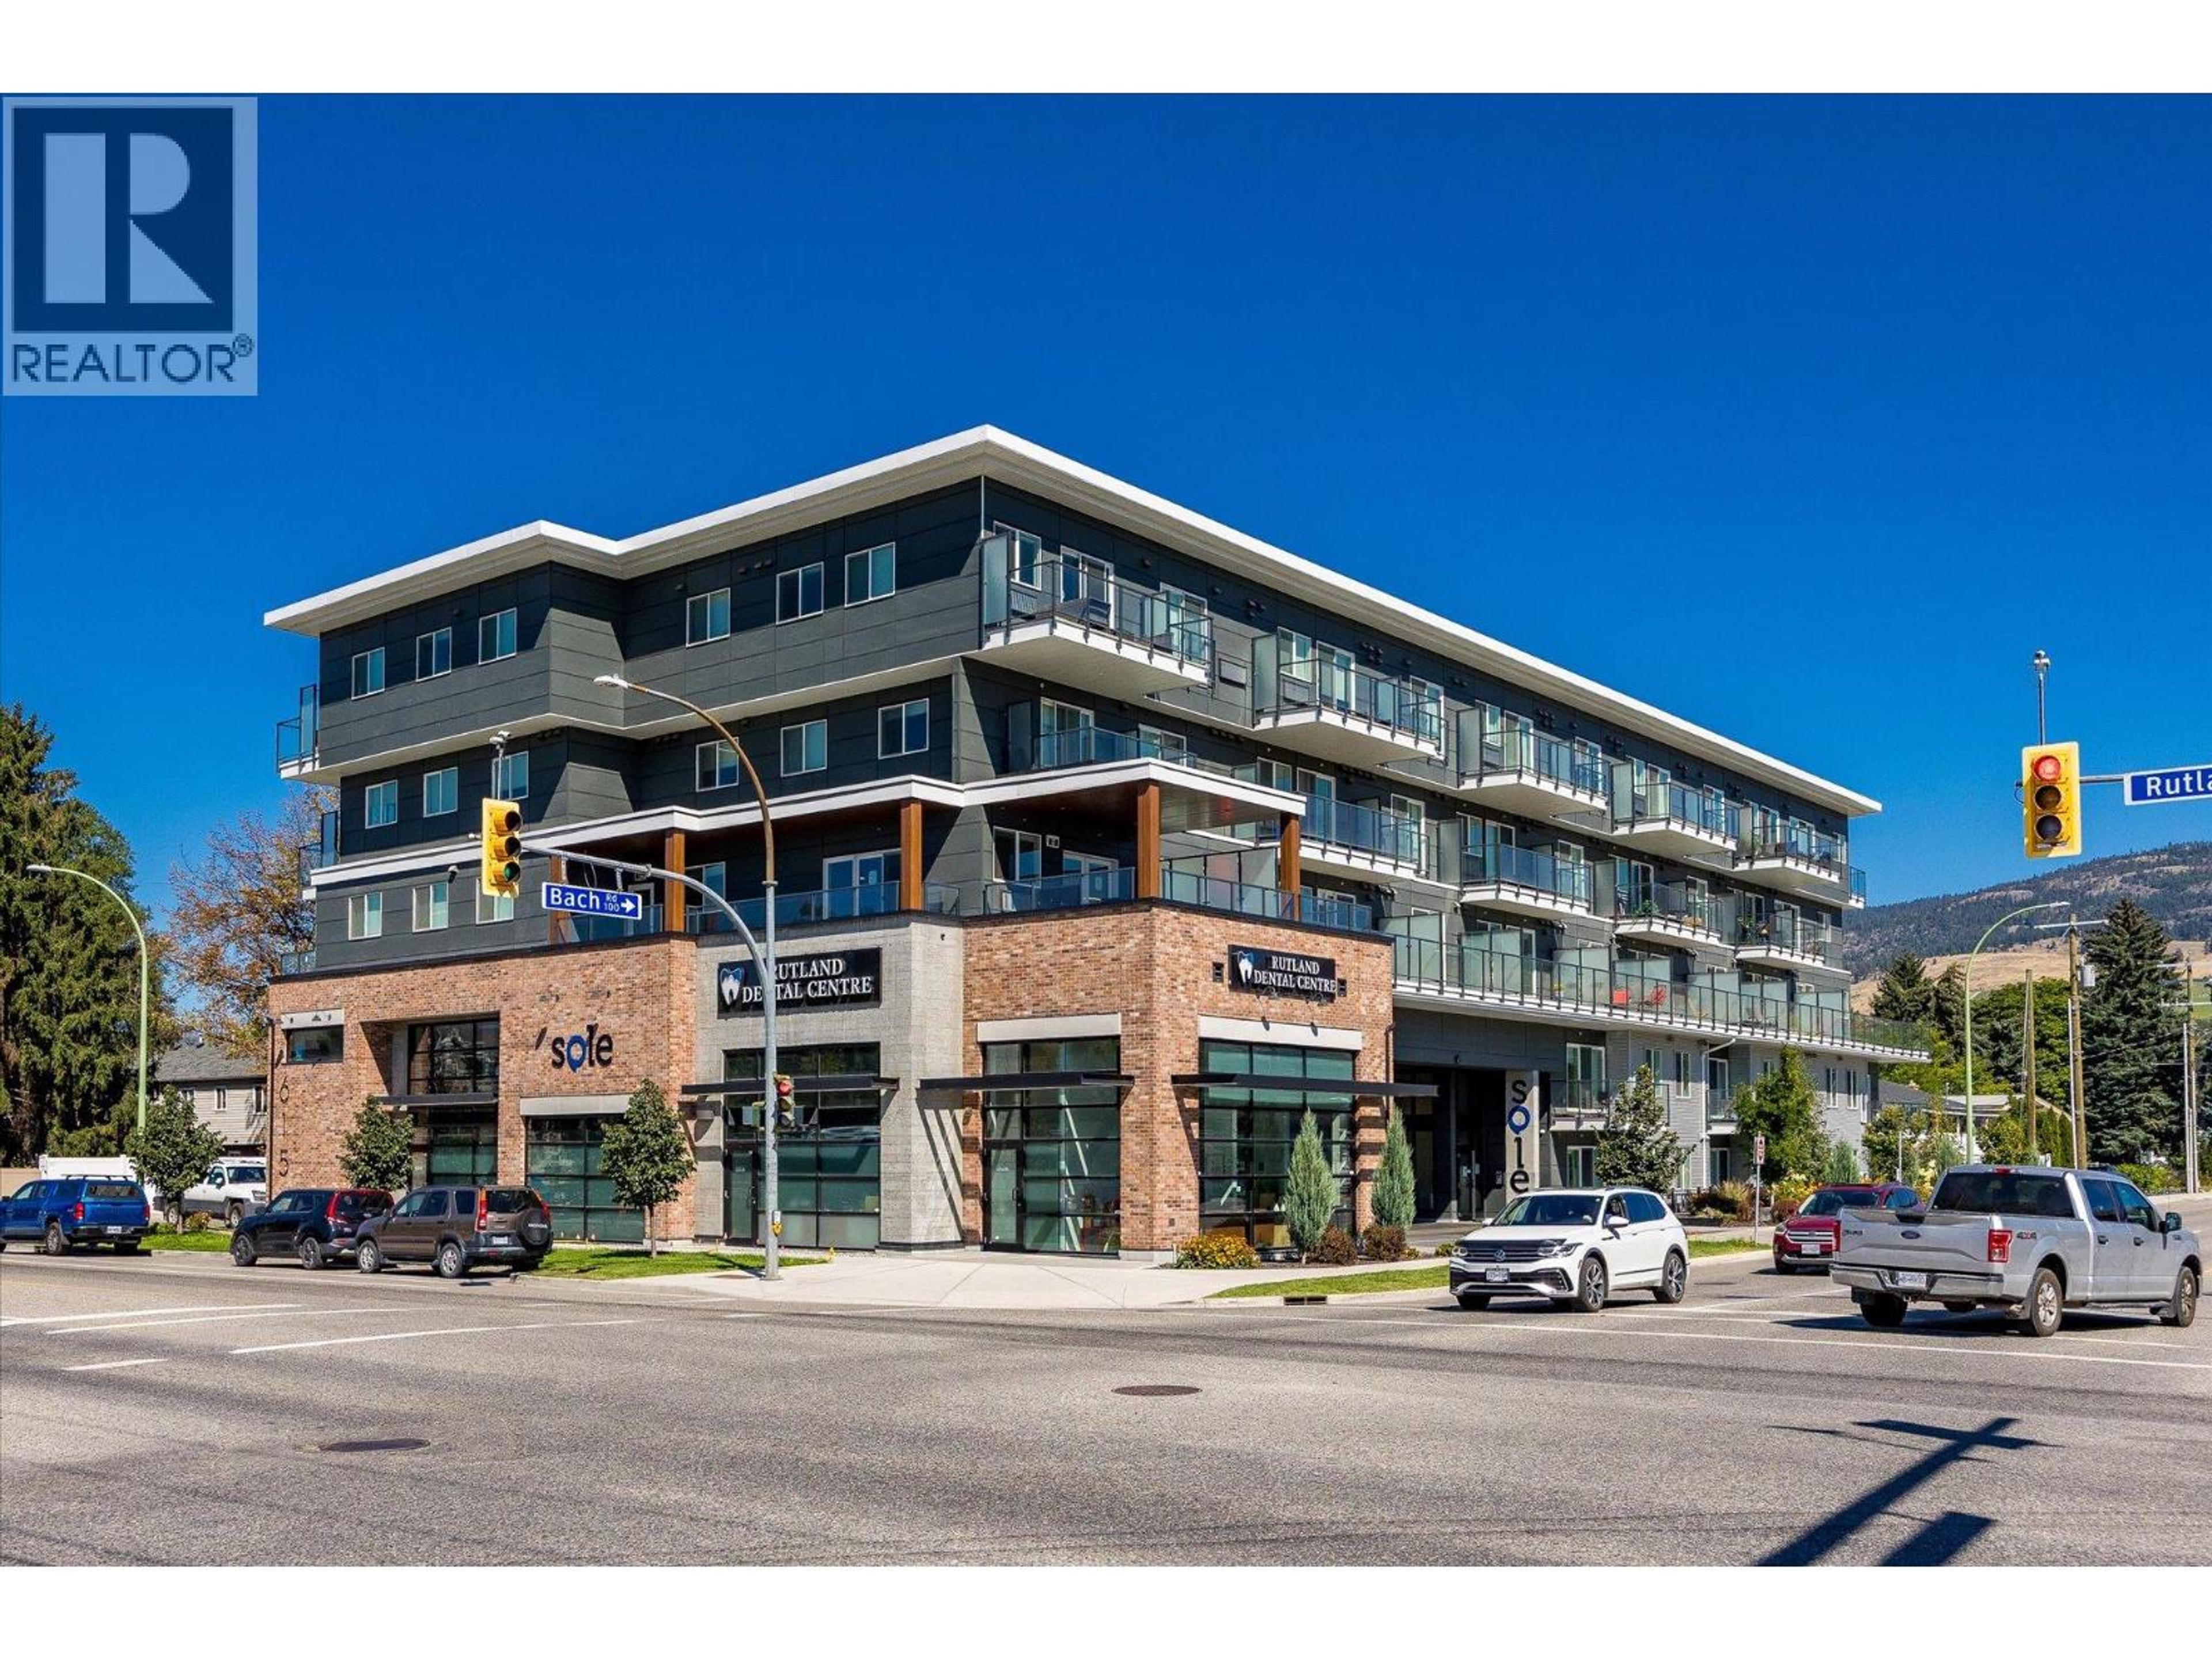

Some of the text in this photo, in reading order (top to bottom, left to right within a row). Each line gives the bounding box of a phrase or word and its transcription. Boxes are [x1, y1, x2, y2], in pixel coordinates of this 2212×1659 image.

[551, 888, 600, 910] Bach
[604, 902, 620, 912] 100
[606, 893, 617, 902] Rd
[1271, 956, 1320, 975] RUTLAND
[743, 976, 872, 1003] DETAL CENTRE
[1253, 969, 1337, 993] DENTAL CENTRE
[1507, 1080, 1531, 1194] sole
